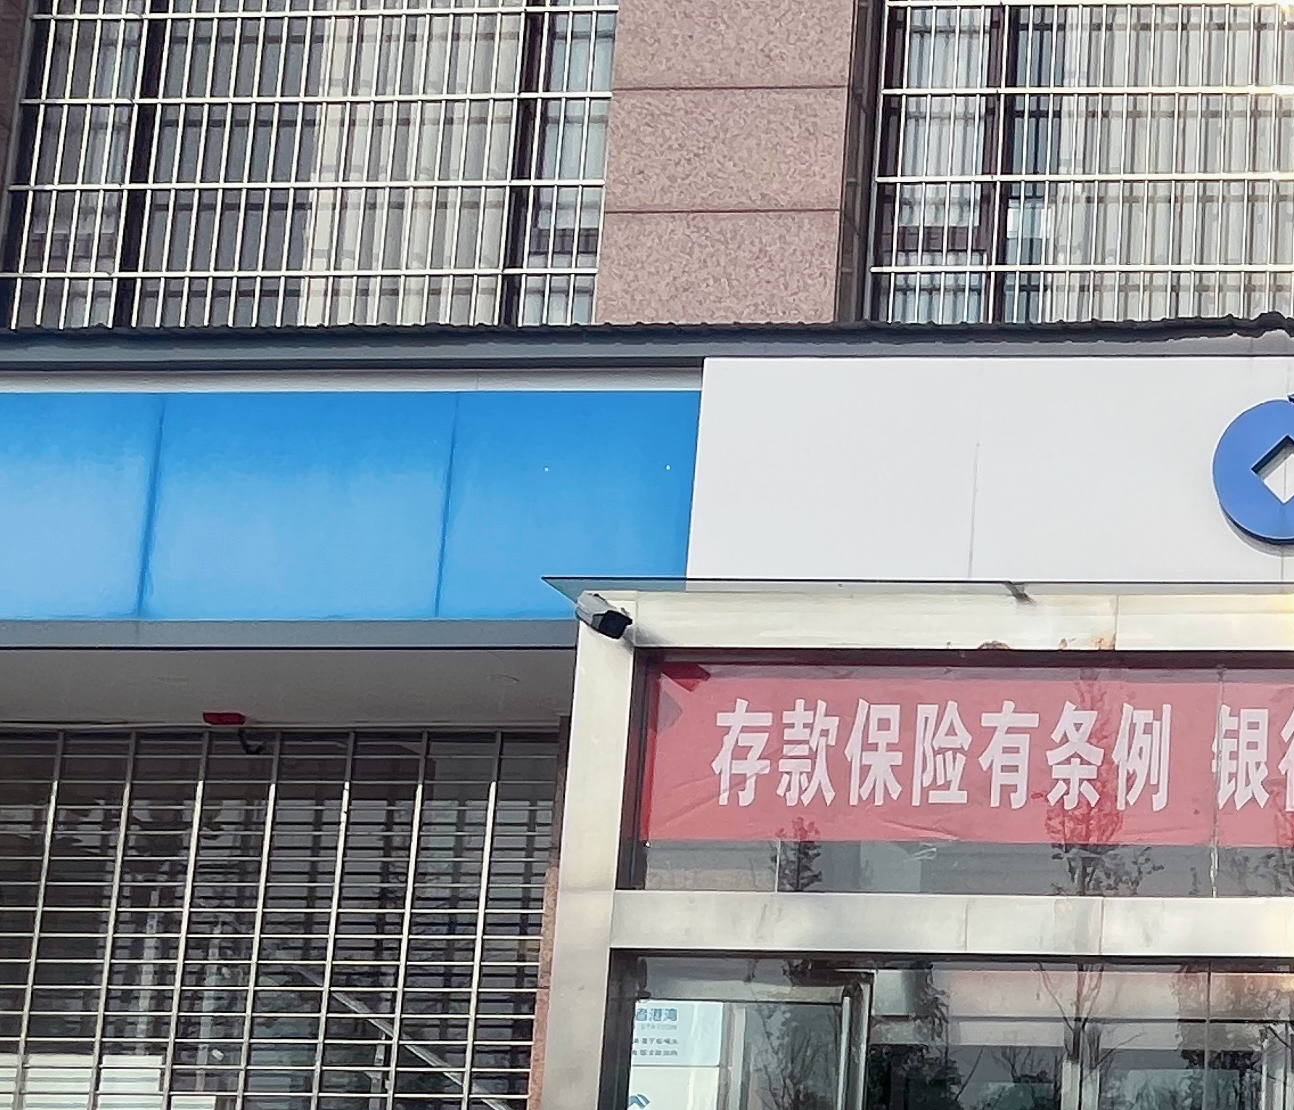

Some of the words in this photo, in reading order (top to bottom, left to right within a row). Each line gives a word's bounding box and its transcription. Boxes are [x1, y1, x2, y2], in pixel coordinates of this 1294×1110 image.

[713, 698, 1171, 809] 存款保险有条例
